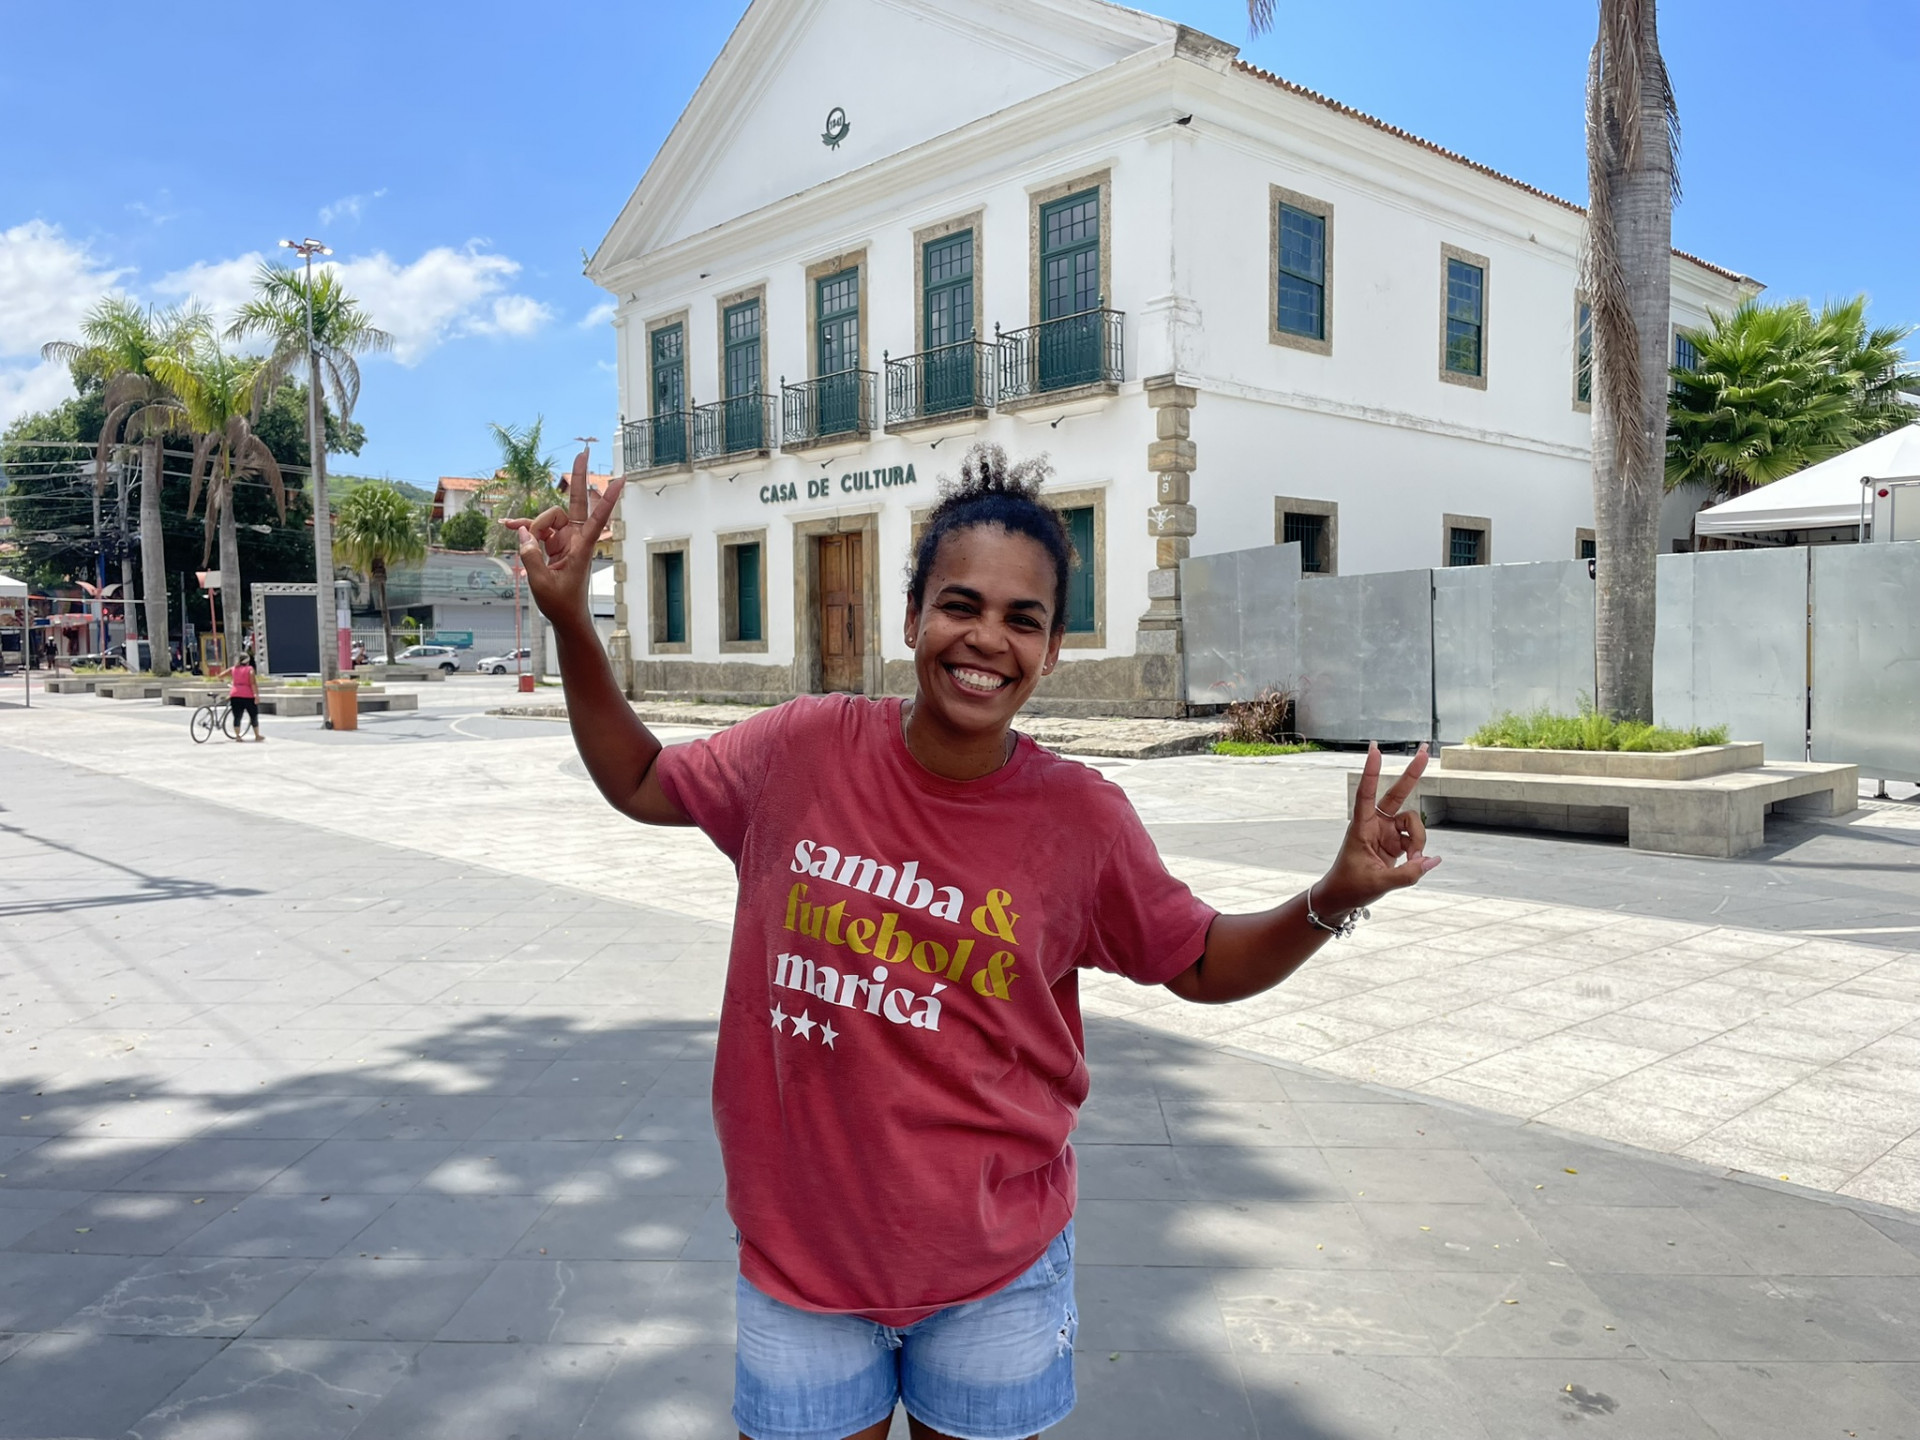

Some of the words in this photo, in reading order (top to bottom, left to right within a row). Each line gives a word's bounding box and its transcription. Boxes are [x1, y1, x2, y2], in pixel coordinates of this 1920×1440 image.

[759, 481, 798, 504] CASA
[807, 478, 829, 499] DE
[840, 463, 917, 493] CULTURA
[790, 839, 964, 924] samba
[971, 888, 1021, 946] &
[782, 882, 976, 983] futebol
[971, 950, 1020, 1001] &
[773, 952, 948, 1032] maricá
